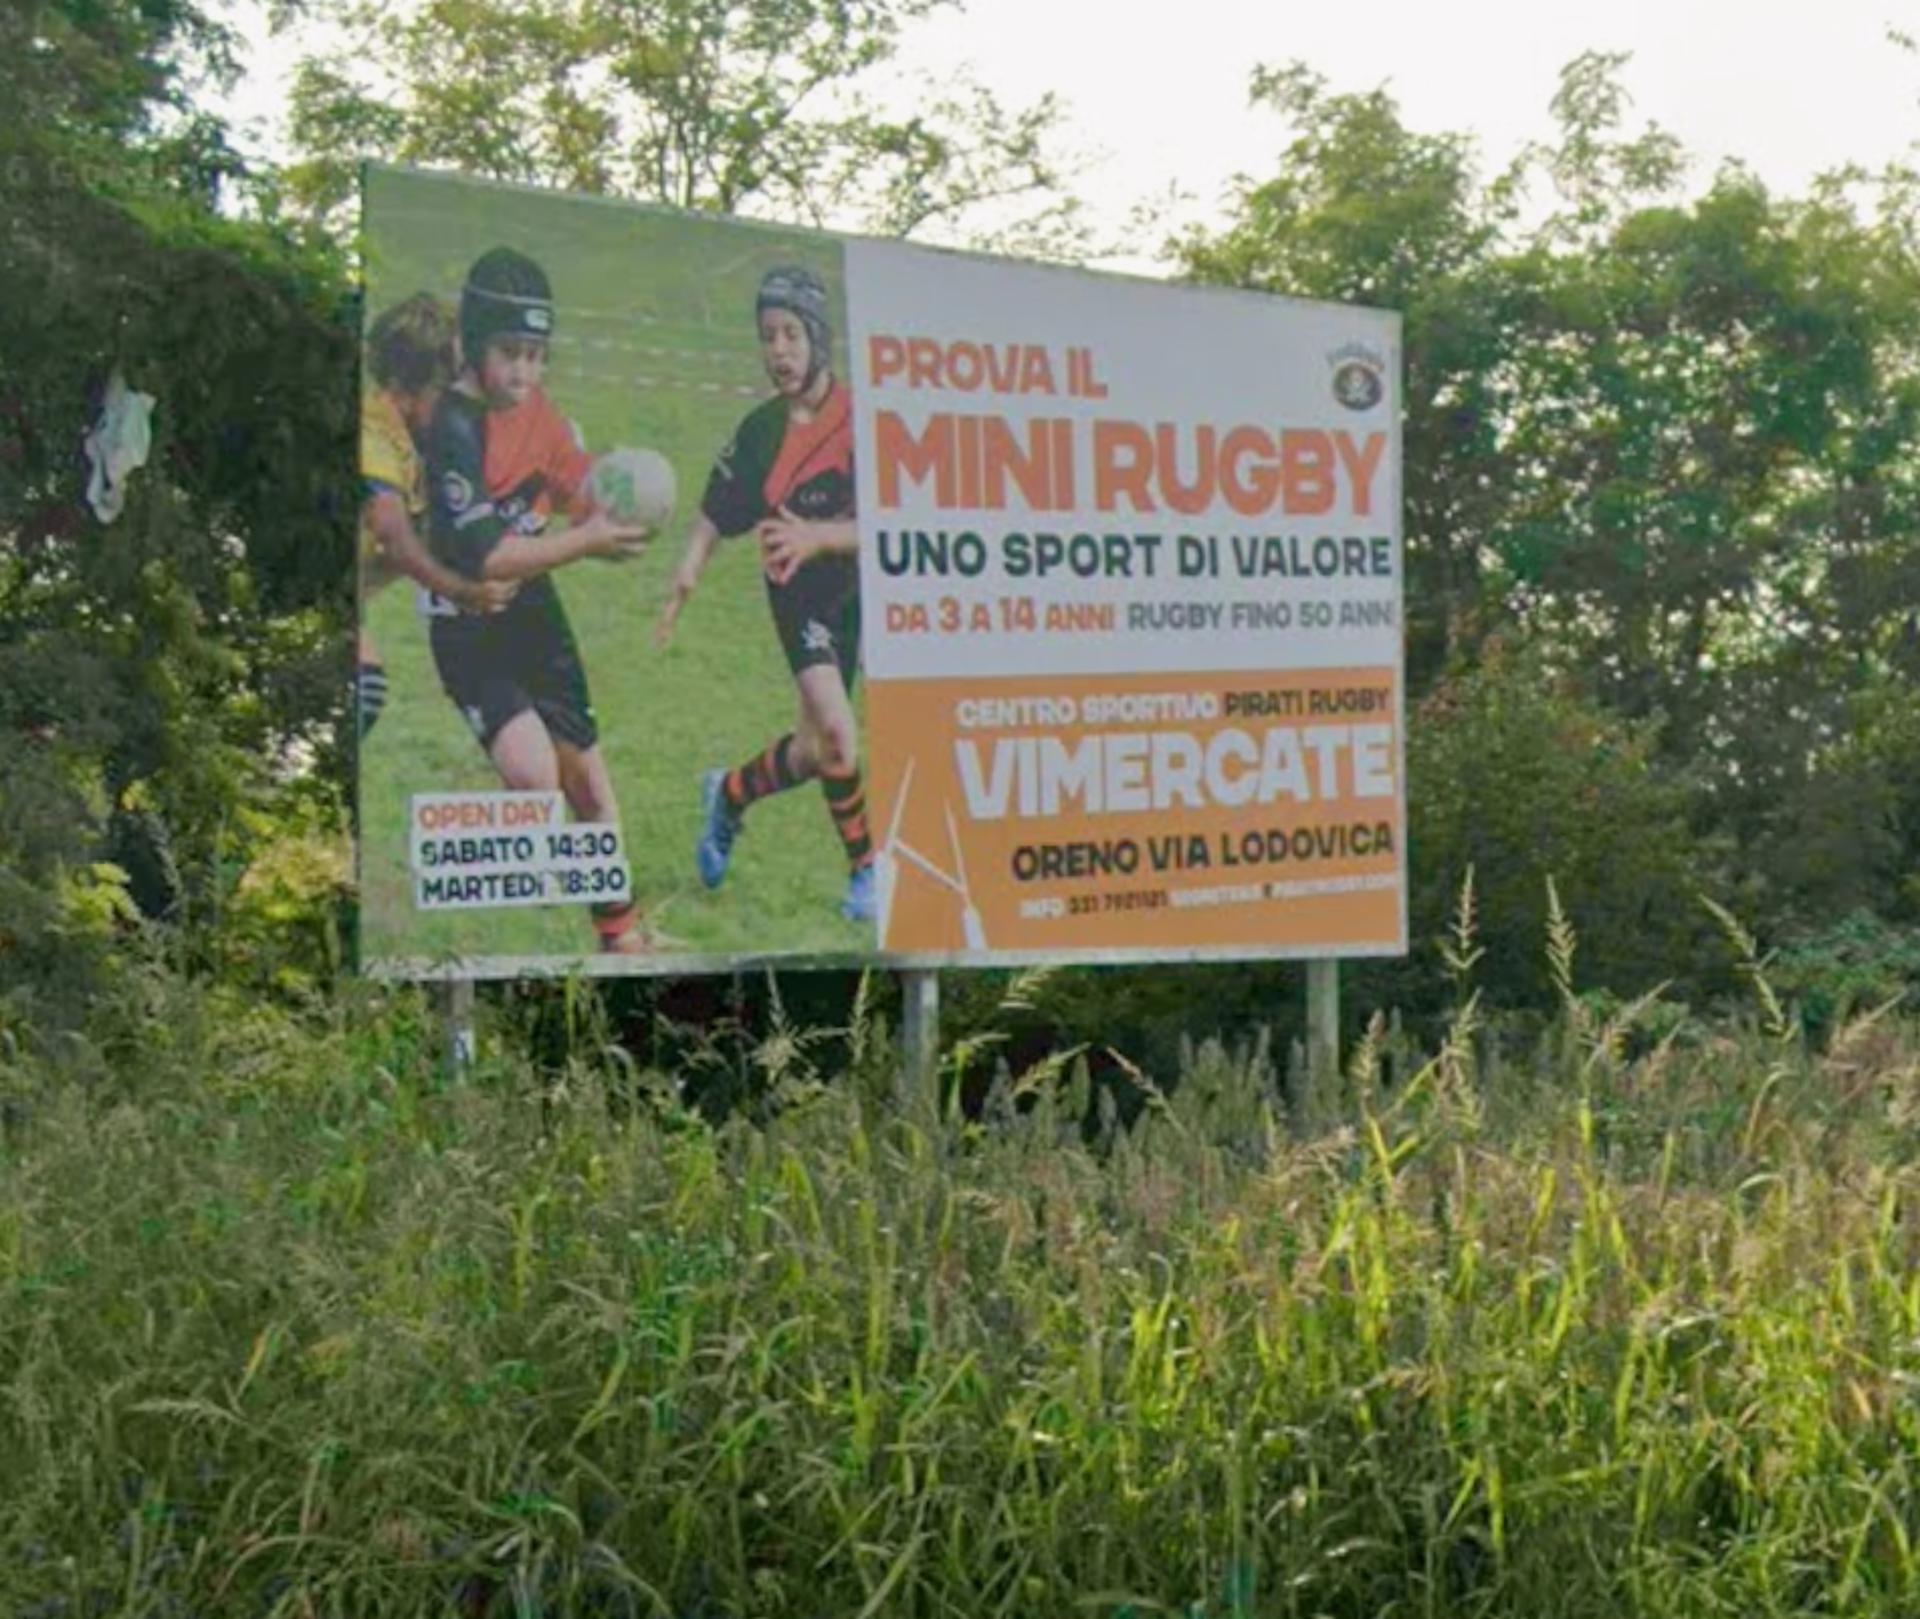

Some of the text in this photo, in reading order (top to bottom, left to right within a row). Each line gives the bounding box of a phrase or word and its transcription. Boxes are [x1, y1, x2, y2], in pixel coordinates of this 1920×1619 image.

[868, 336, 1107, 397] PROVA IL
[873, 411, 1387, 515] MINI RUGBY
[877, 531, 1392, 577] UNO SPORT DI VALORE
[886, 603, 929, 632] DA
[939, 597, 961, 633] 3
[970, 604, 991, 631] A
[999, 598, 1036, 632] 14
[1045, 604, 1115, 630] ANNI
[1128, 602, 1223, 630] RUGBY
[1231, 603, 1290, 628] FINO
[1300, 603, 1333, 628] 50
[955, 688, 1388, 727] CENTRO SPORTIVO PIRATI RUGBY
[955, 723, 1394, 820] VIMERCATE
[419, 801, 554, 828] OPEN DAY
[420, 832, 618, 867] SABATO 14:30
[1012, 822, 1395, 881] ORENO VIA LODOVICA
